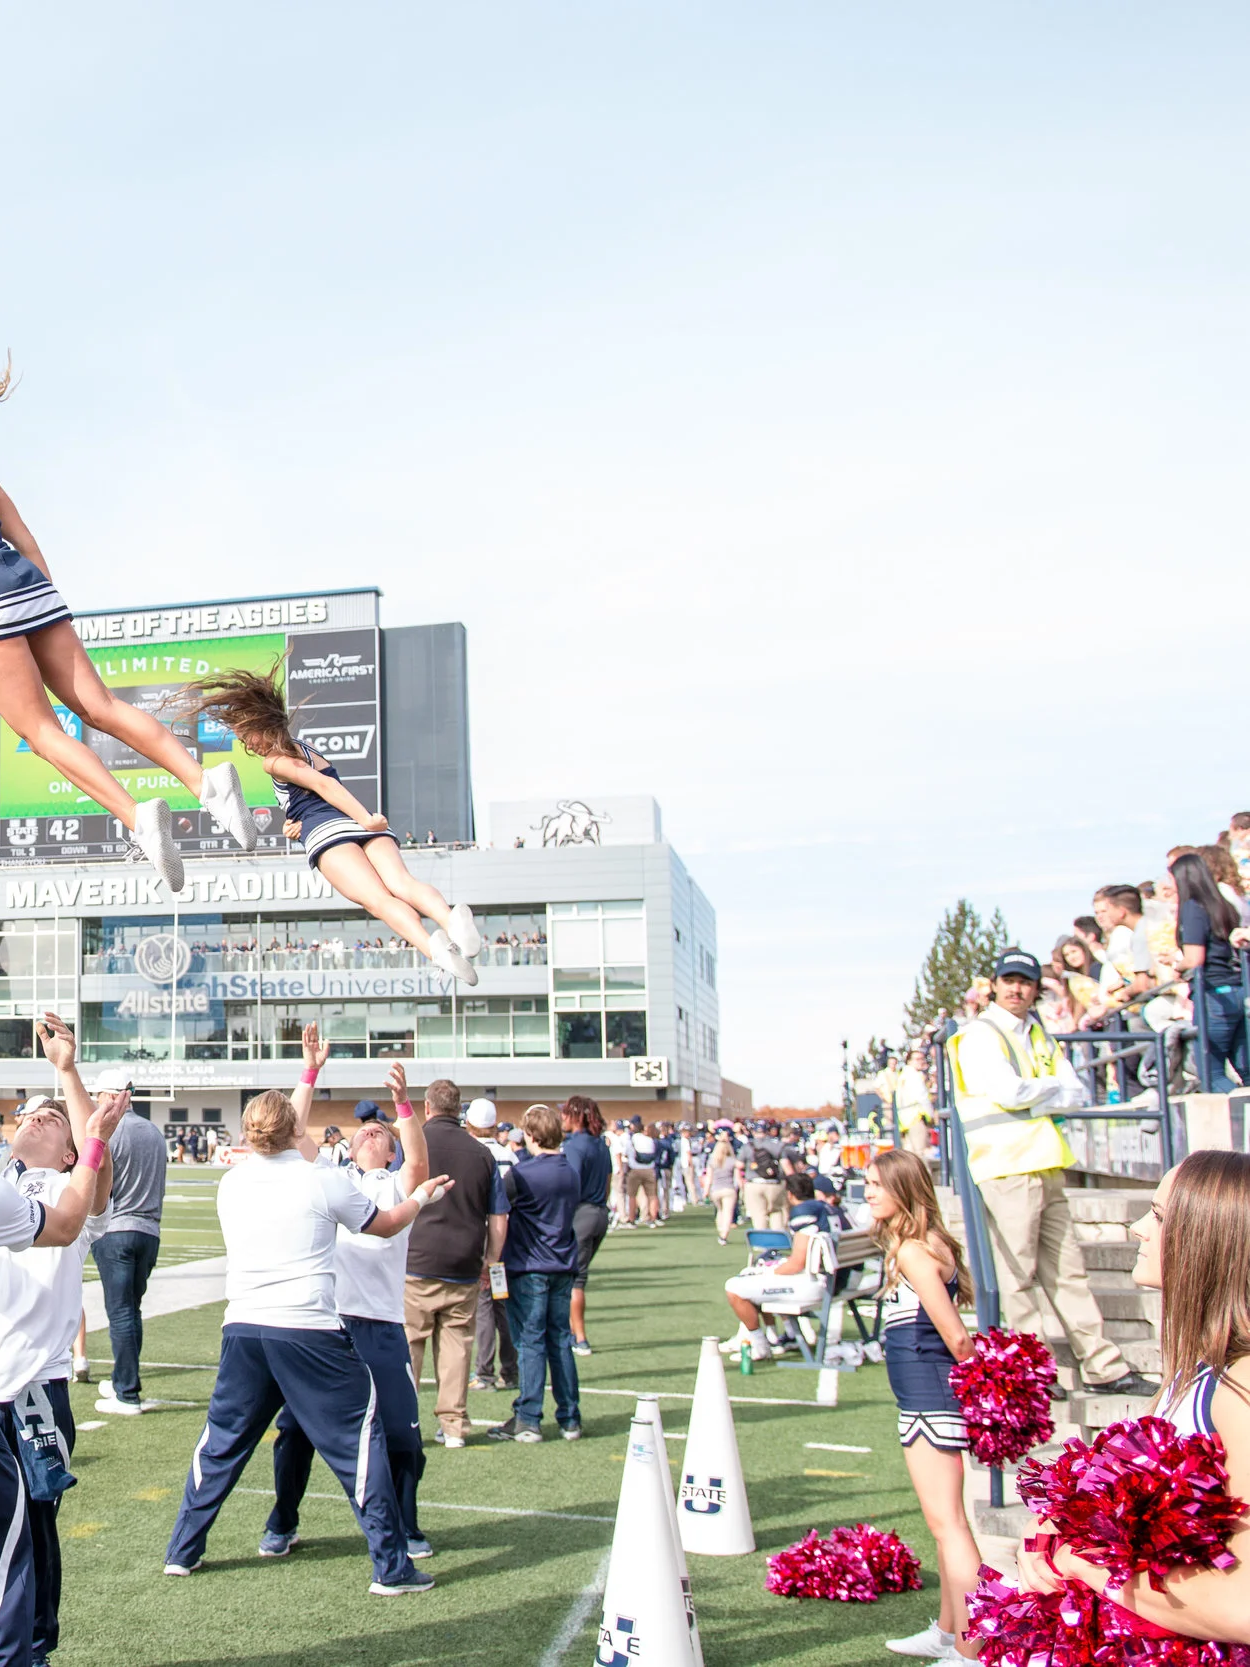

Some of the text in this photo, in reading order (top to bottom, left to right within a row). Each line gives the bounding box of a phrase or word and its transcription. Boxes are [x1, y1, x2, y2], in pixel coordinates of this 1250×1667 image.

[126, 612, 162, 637] OF
[164, 607, 219, 635] THE
[222, 599, 328, 629] AGGIES
[290, 664, 375, 680] AMERICA FIRST
[48, 782, 72, 794] ON
[136, 775, 184, 789] PURC
[6, 826, 39, 837] STATE
[49, 818, 80, 841] 42
[199, 839, 230, 849] QTR 2
[269, 836, 277, 847] 3
[28, 847, 36, 857] 3
[60, 846, 88, 855] DOWN
[101, 844, 128, 853] TO GO
[6, 876, 164, 908] MAVERIK
[117, 989, 208, 1014] Allstate
[681, 1485, 727, 1504] STATE
